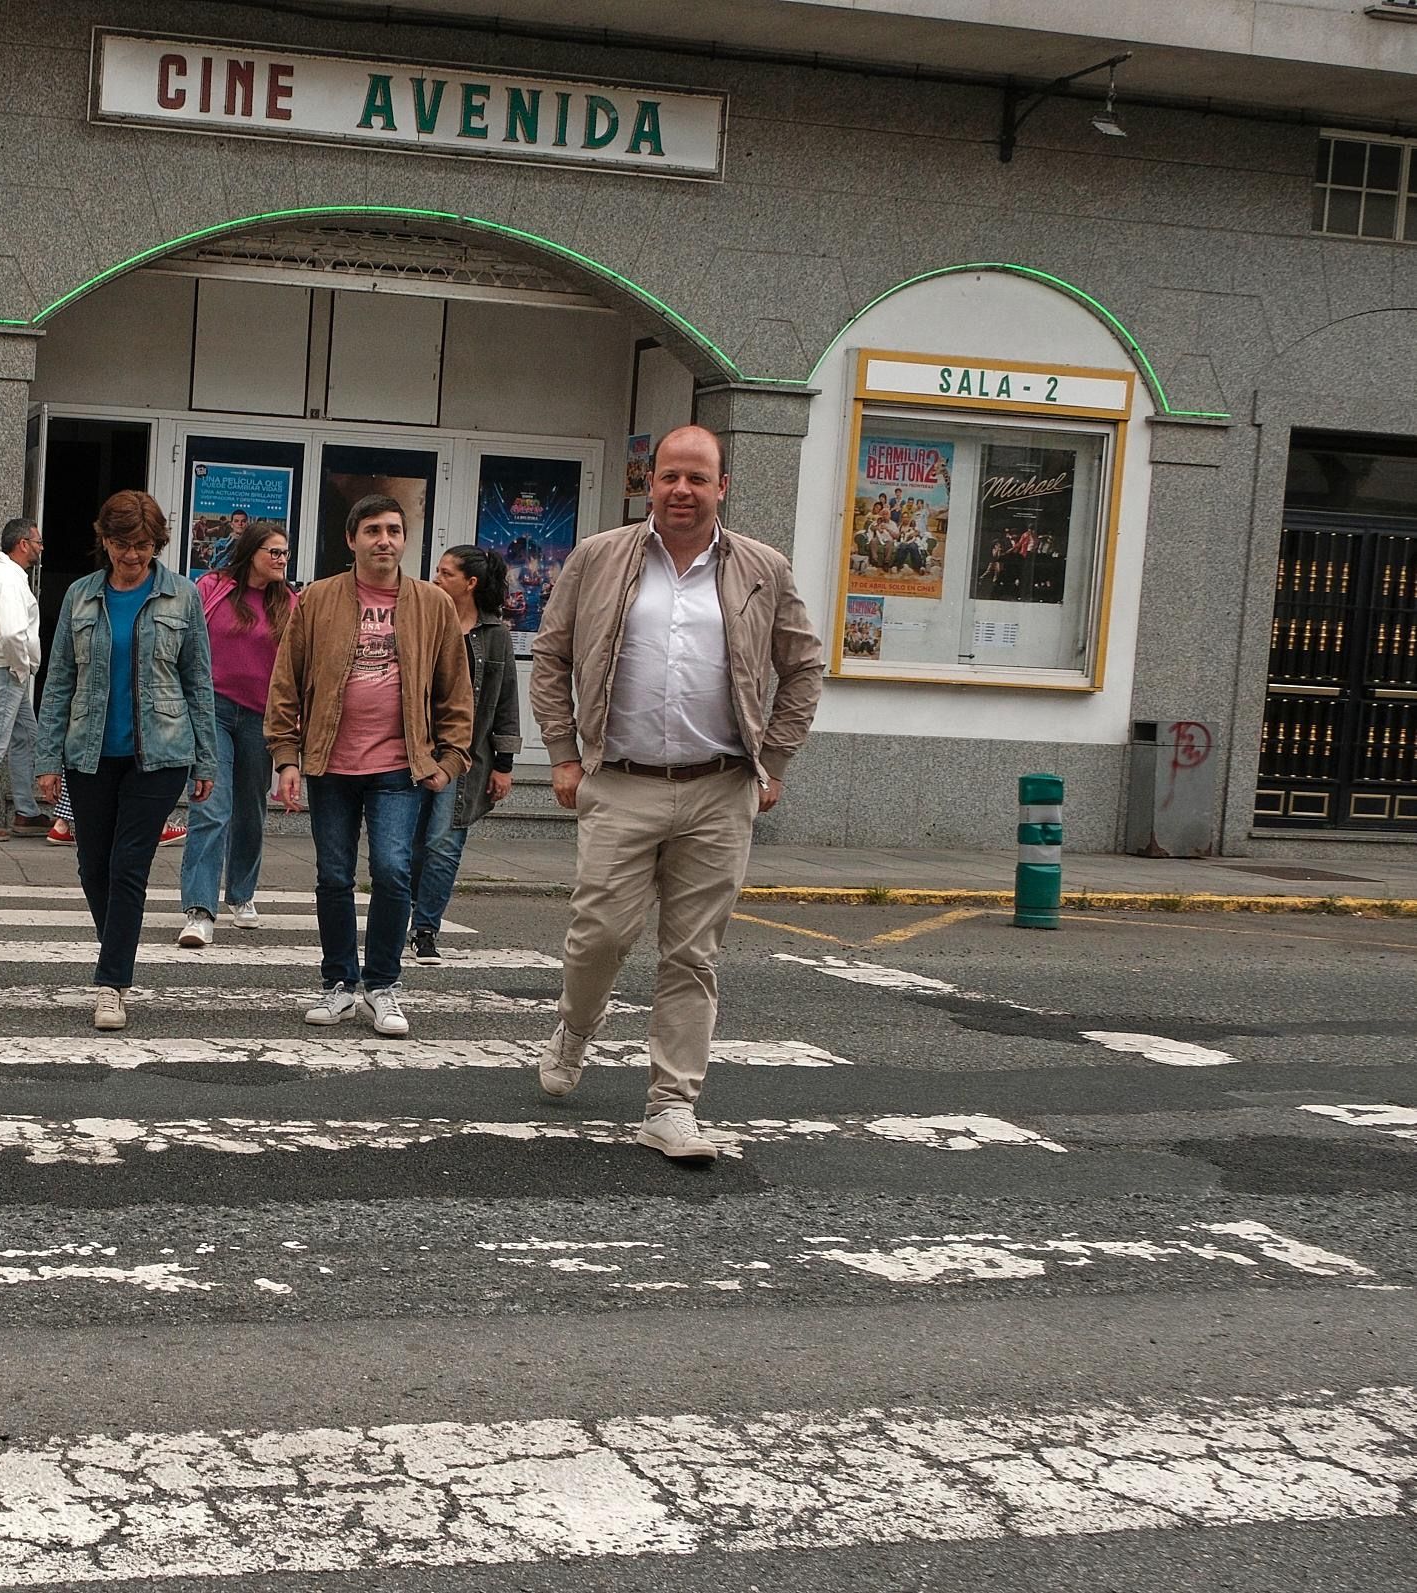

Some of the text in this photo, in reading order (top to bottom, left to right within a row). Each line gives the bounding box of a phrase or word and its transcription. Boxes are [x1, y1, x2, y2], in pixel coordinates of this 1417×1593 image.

[156, 54, 665, 156] CINE AVENIDA
[939, 367, 1011, 398] SALA
[1045, 376, 1058, 402] 2
[878, 445, 925, 464] FAMILIA
[866, 456, 924, 482] BENETON
[222, 477, 262, 486] PELÍCULA
[981, 472, 1072, 502] Michael
[869, 582, 887, 590] ABRIL
[361, 622, 380, 631] USA
